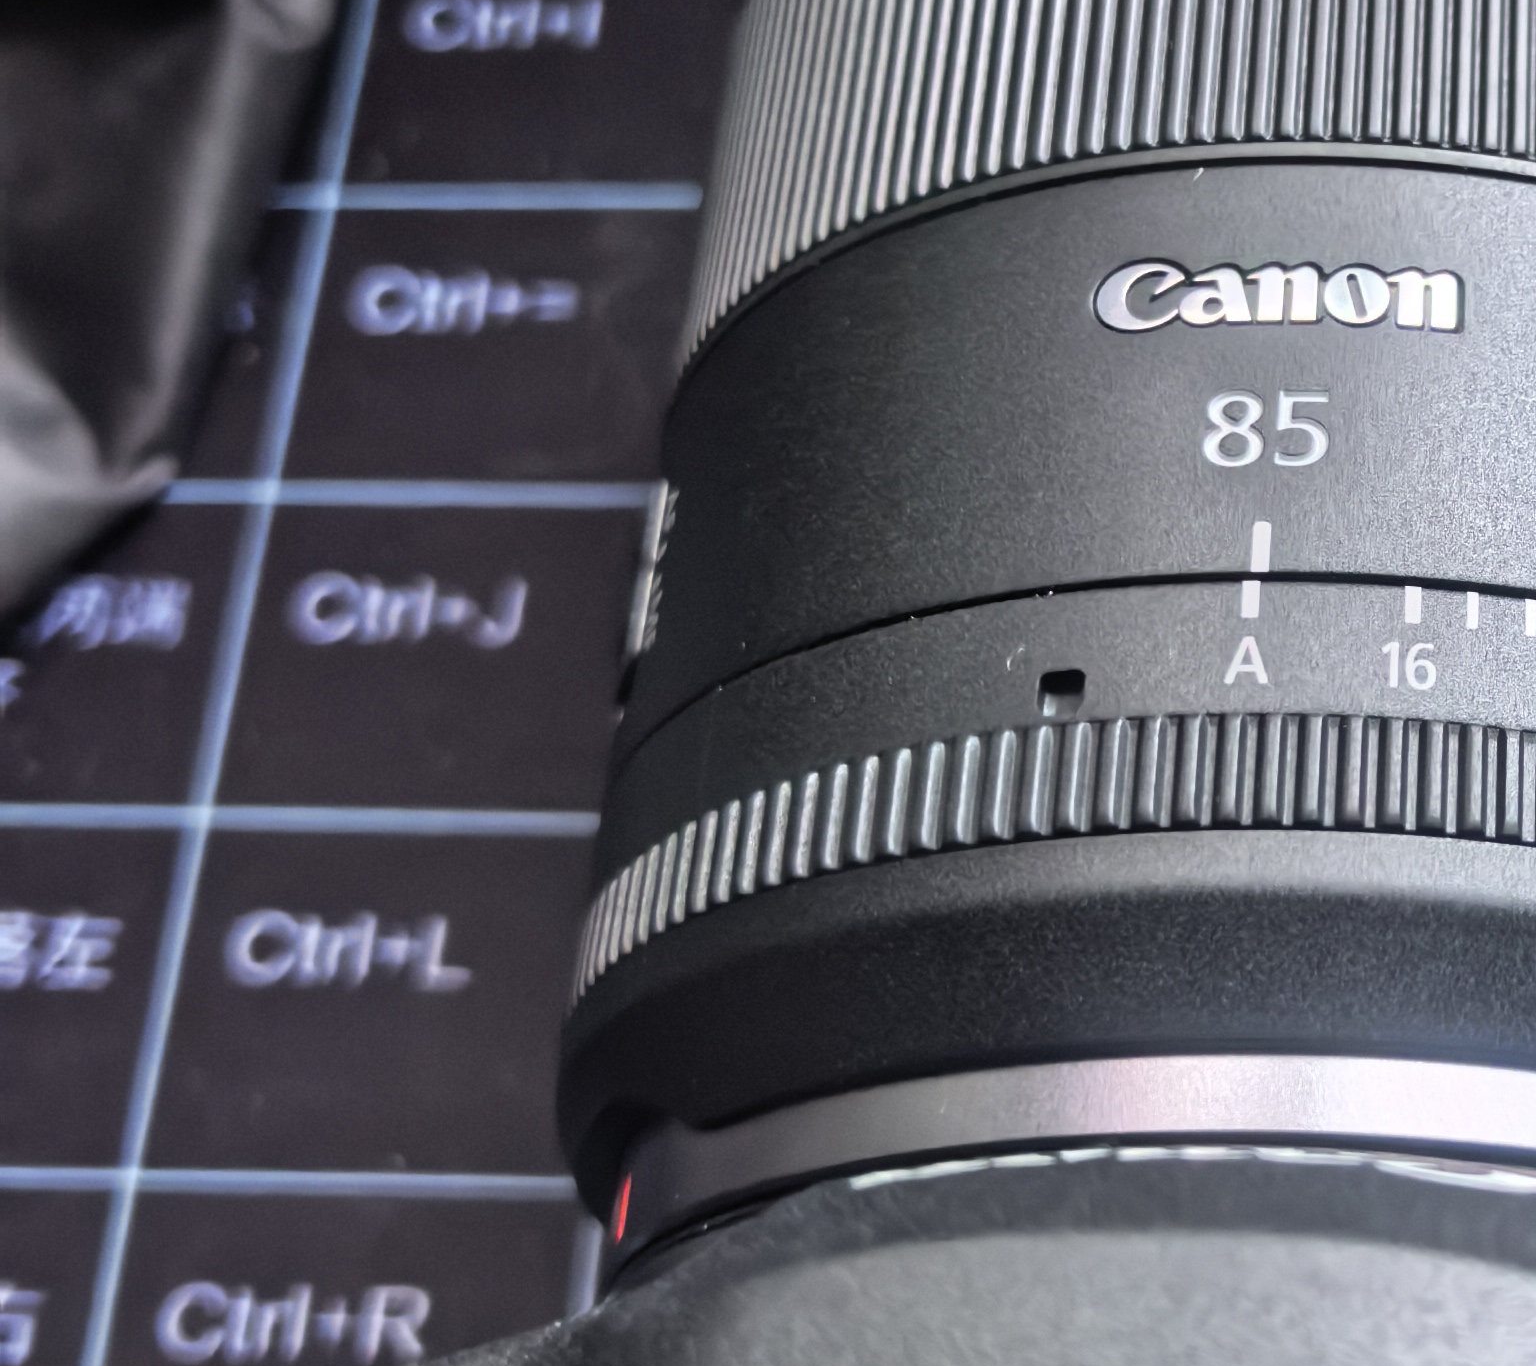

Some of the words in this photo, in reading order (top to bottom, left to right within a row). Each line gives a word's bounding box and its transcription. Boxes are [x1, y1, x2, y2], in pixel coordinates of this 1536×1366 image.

[1093, 258, 1464, 333] Canon
[1202, 389, 1331, 467] 85
[291, 570, 530, 649] Ctrl+J
[1223, 636, 1269, 684] A
[1381, 641, 1438, 691] 16
[224, 907, 471, 992] Ctrl+L
